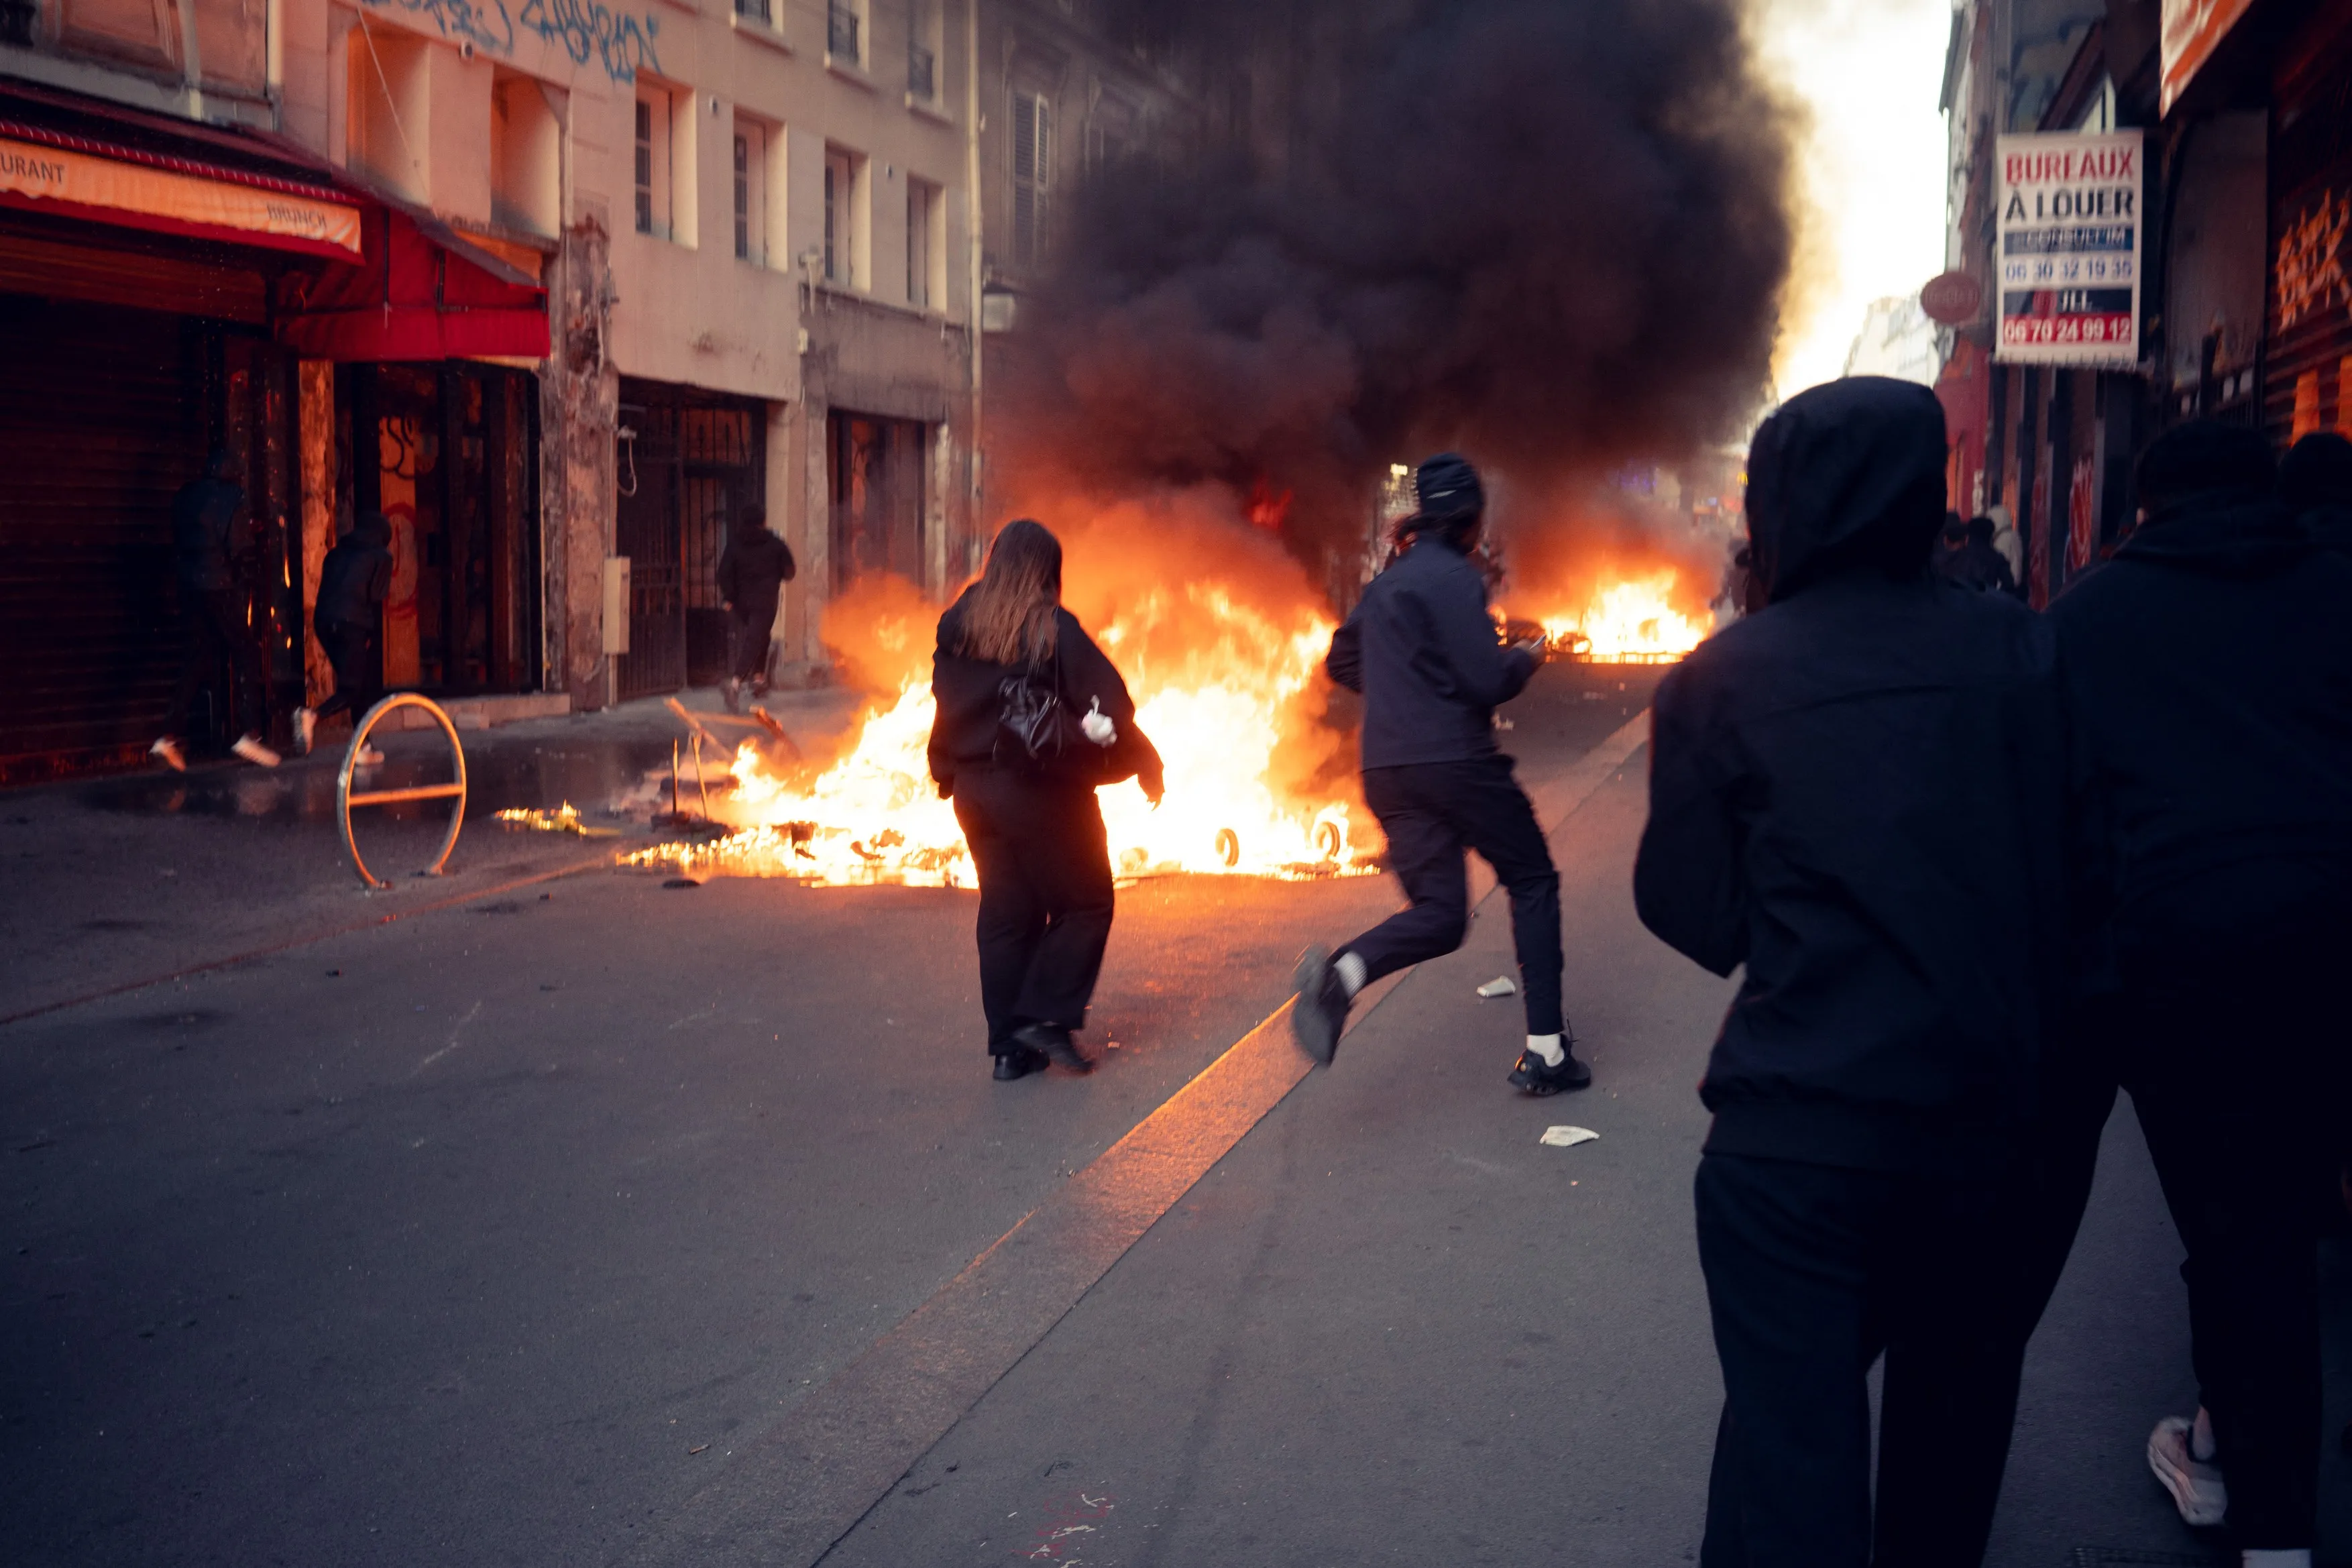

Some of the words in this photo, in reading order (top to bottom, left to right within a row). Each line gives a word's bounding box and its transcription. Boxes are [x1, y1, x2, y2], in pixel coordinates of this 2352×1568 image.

[2006, 148, 2135, 186] BUREAUX
[267, 203, 327, 231] BRUNCH
[2037, 187, 2135, 220] LOUER
[2004, 319, 2027, 343] 06
[2030, 318, 2053, 343] 70
[2056, 317, 2079, 343] 24
[2109, 316, 2131, 341] 12
